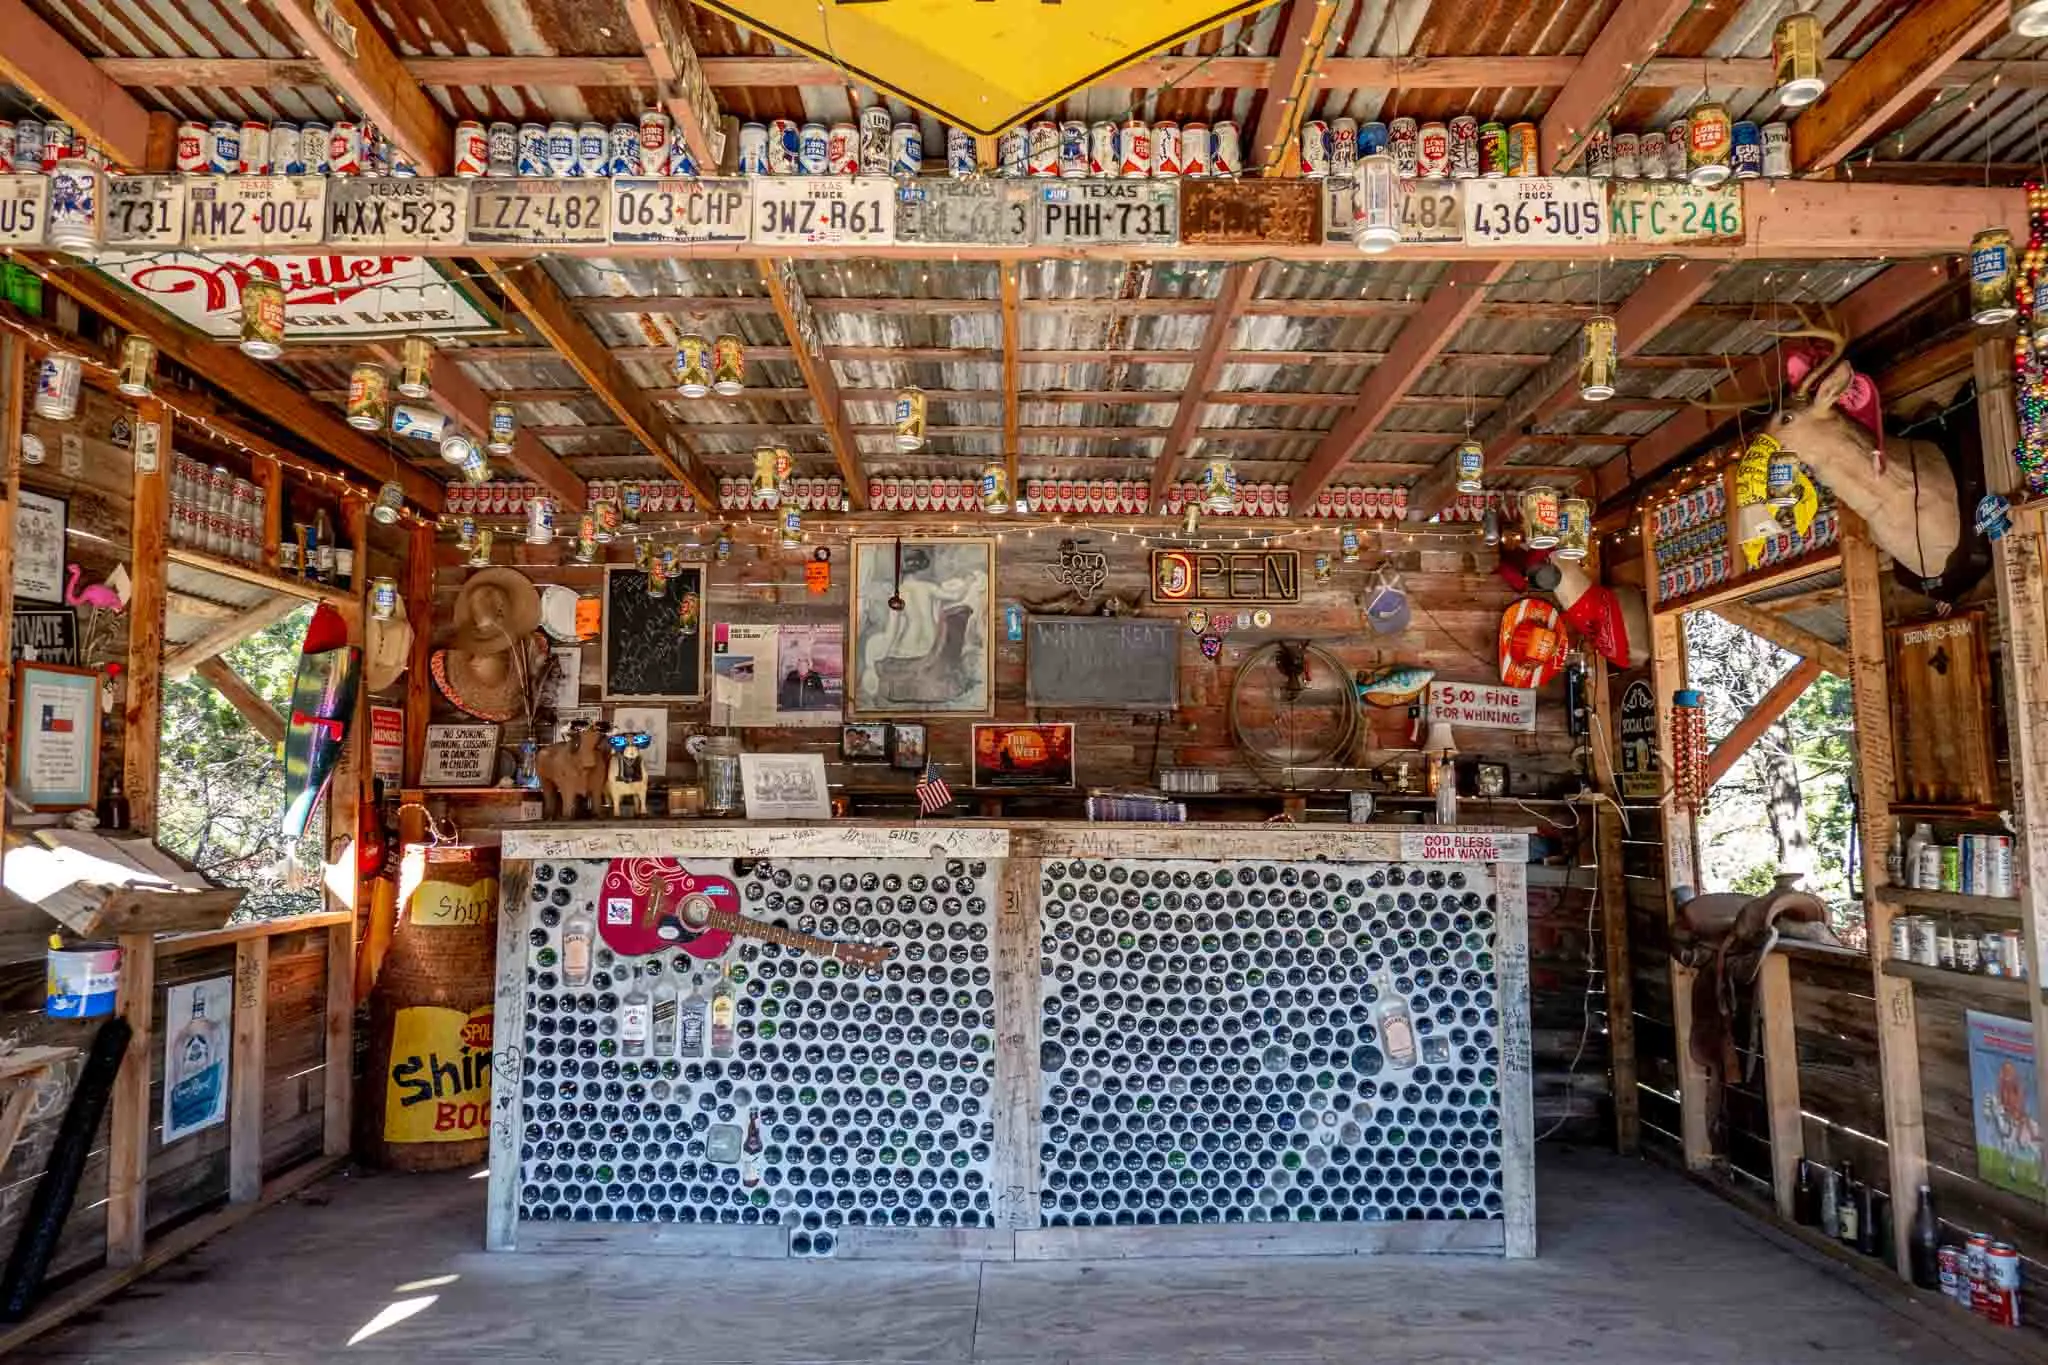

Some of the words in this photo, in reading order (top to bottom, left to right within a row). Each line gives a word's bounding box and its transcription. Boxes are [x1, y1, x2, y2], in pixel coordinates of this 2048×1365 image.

[643, 127, 665, 135] LONE
[1695, 125, 1724, 135] LONE
[1695, 133, 1724, 143] STAR
[239, 180, 274, 190] TEXAS
[369, 182, 426, 198] TEXAS
[808, 182, 843, 191] TEXAS
[1519, 182, 1554, 192] TEXAS
[239, 191, 273, 199] TRUCK
[808, 191, 843, 199] TRUCK
[1049, 189, 1068, 200] JUN
[1081, 184, 1138, 199] TEXAS
[1518, 191, 1554, 200] TRUCK
[1972, 252, 2001, 263] LONE
[1972, 262, 2001, 275] STAR
[131, 256, 414, 313] Miller
[356, 309, 455, 325] LIFE
[1159, 553, 1294, 598] OPEN
[13, 615, 65, 647] RIVATE
[1435, 706, 1458, 720] FOR
[443, 729, 454, 739] NO
[440, 750, 450, 759] OR
[451, 749, 480, 759] DANCING
[440, 760, 448, 769] IN
[449, 760, 479, 769] CHURCH
[1424, 836, 1451, 847] GOD
[1454, 836, 1492, 848] BLESS
[1423, 847, 1455, 859] JOHN
[1457, 848, 1500, 860] WAYNE
